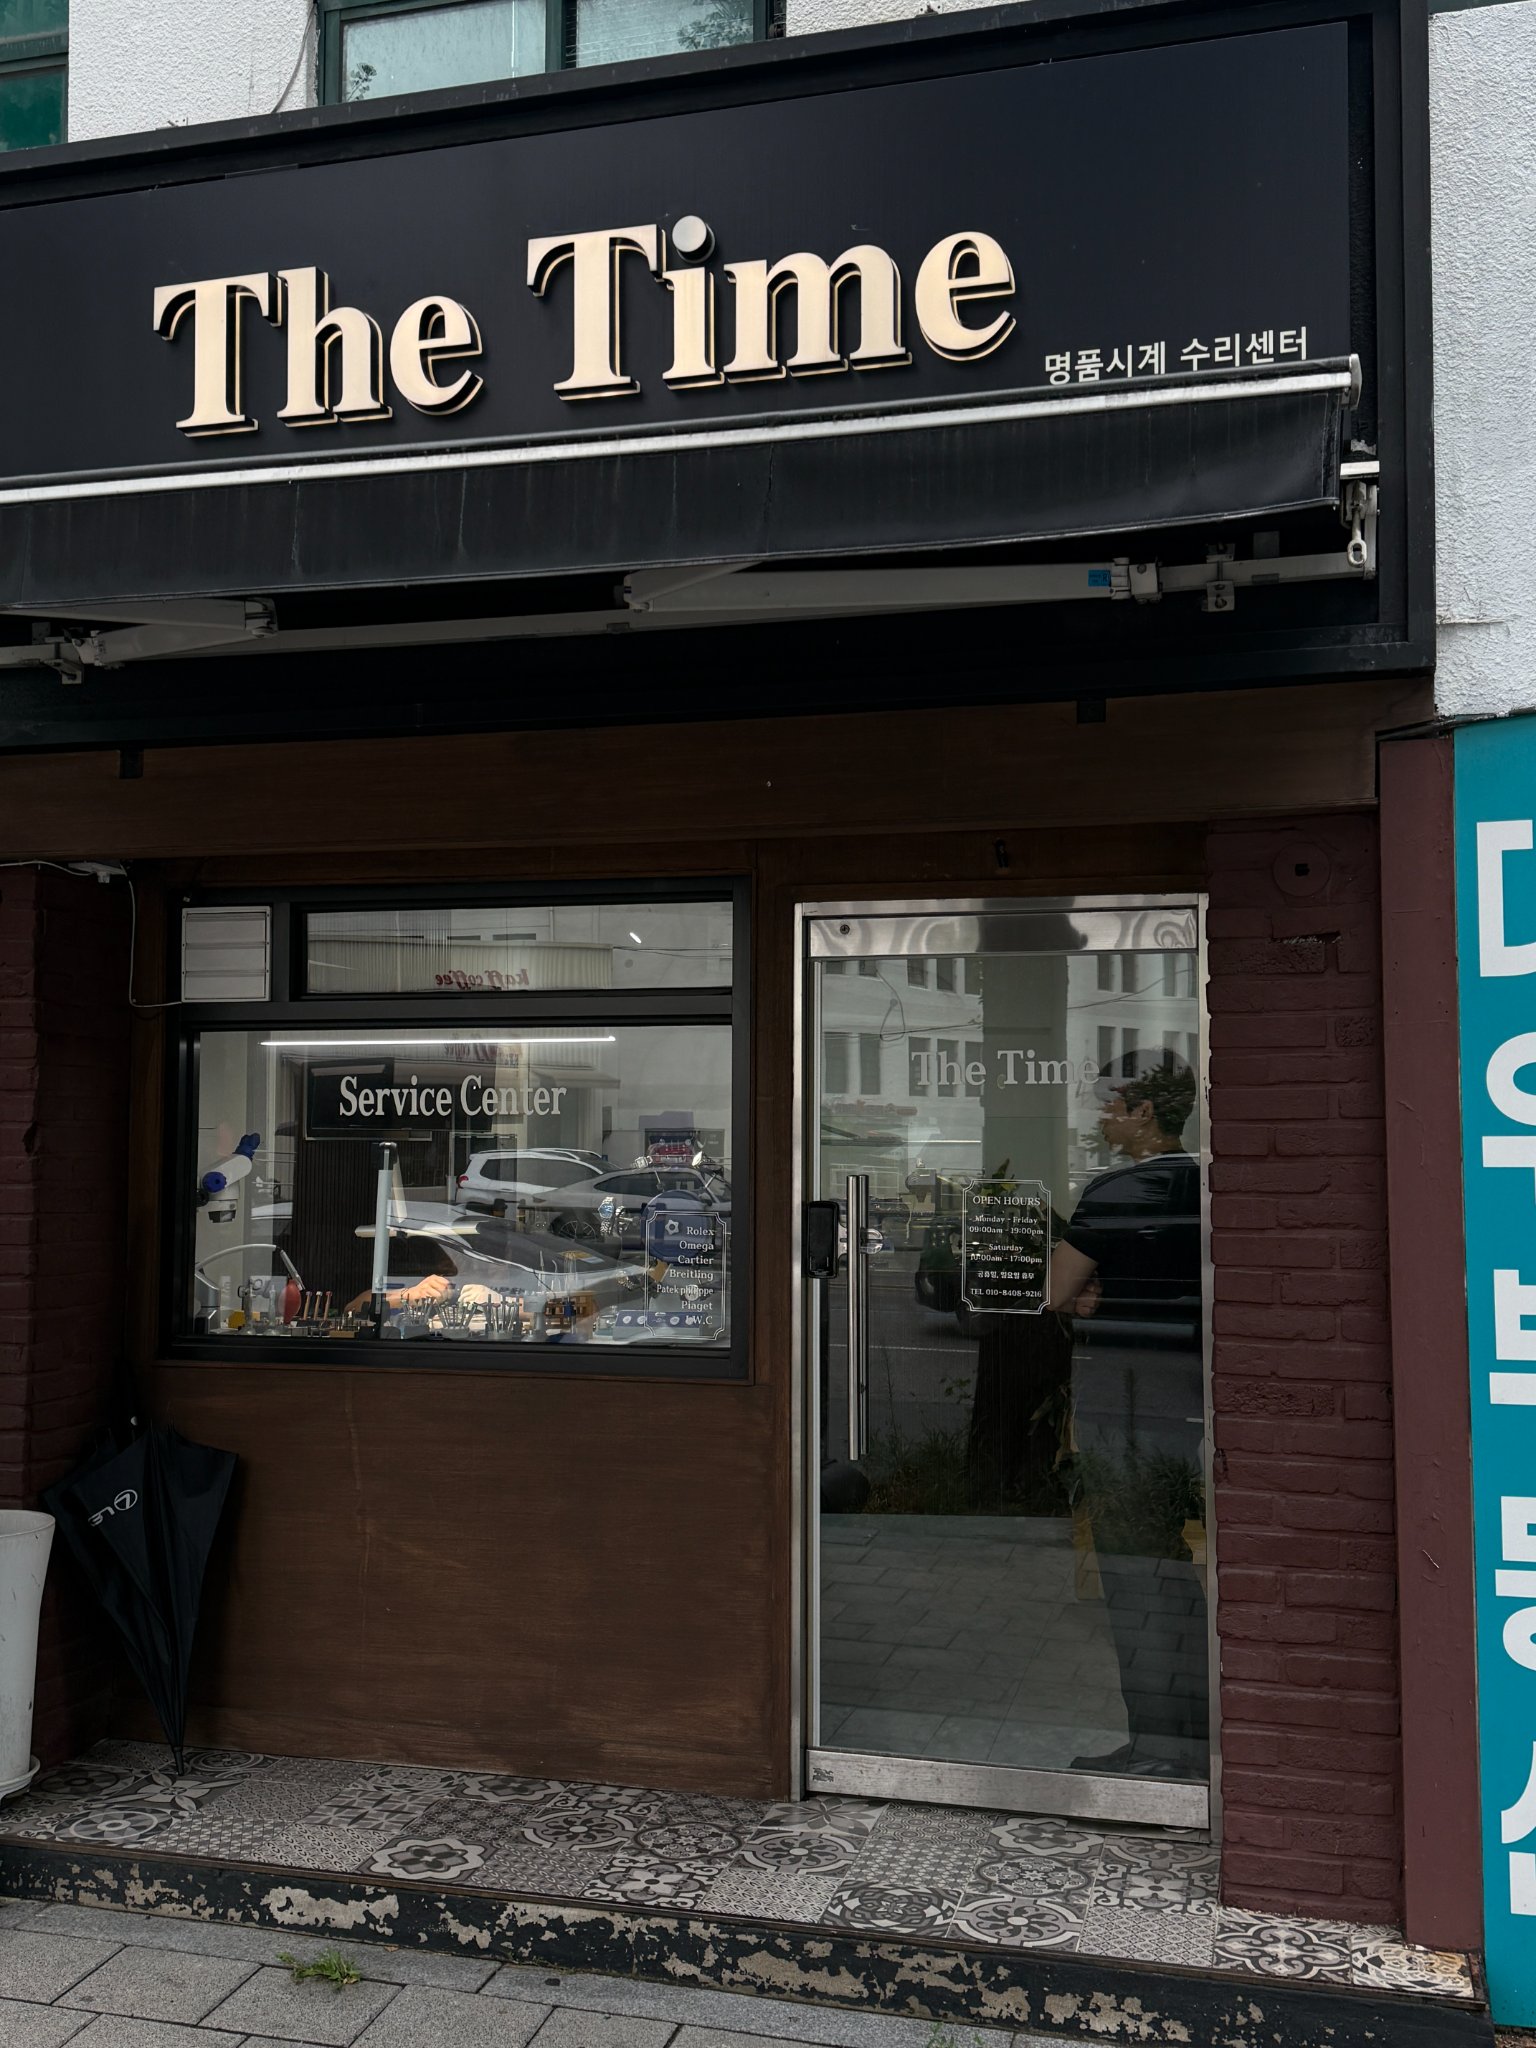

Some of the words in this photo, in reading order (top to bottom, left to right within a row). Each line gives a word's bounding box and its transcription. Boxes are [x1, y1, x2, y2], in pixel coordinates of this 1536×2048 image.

[153, 266, 482, 437] The
[526, 215, 1016, 401] Time
[1044, 340, 1166, 386] 명품시계
[1180, 326, 1307, 372] 수리센터
[911, 1051, 987, 1086] The
[997, 1049, 1100, 1085] Time
[339, 1075, 452, 1117] Service
[460, 1074, 567, 1117] Center
[972, 1195, 1001, 1205] OPEN
[1003, 1196, 1041, 1206] HOURS
[975, 1215, 1006, 1224] Monday
[1013, 1216, 1038, 1225] Friday
[686, 1226, 715, 1236] Rolex
[969, 1225, 1003, 1234] 09:00am
[1010, 1227, 1044, 1236] 19:00pm
[679, 1240, 715, 1253] Omega
[988, 1243, 1024, 1253] Saturday
[677, 1255, 714, 1265] Cartier
[1010, 1255, 1043, 1265] 17:00pm
[669, 1268, 714, 1281] Breitling
[656, 1284, 679, 1294] Patek
[970, 1288, 985, 1296] TEL
[681, 1300, 713, 1312] Piaget
